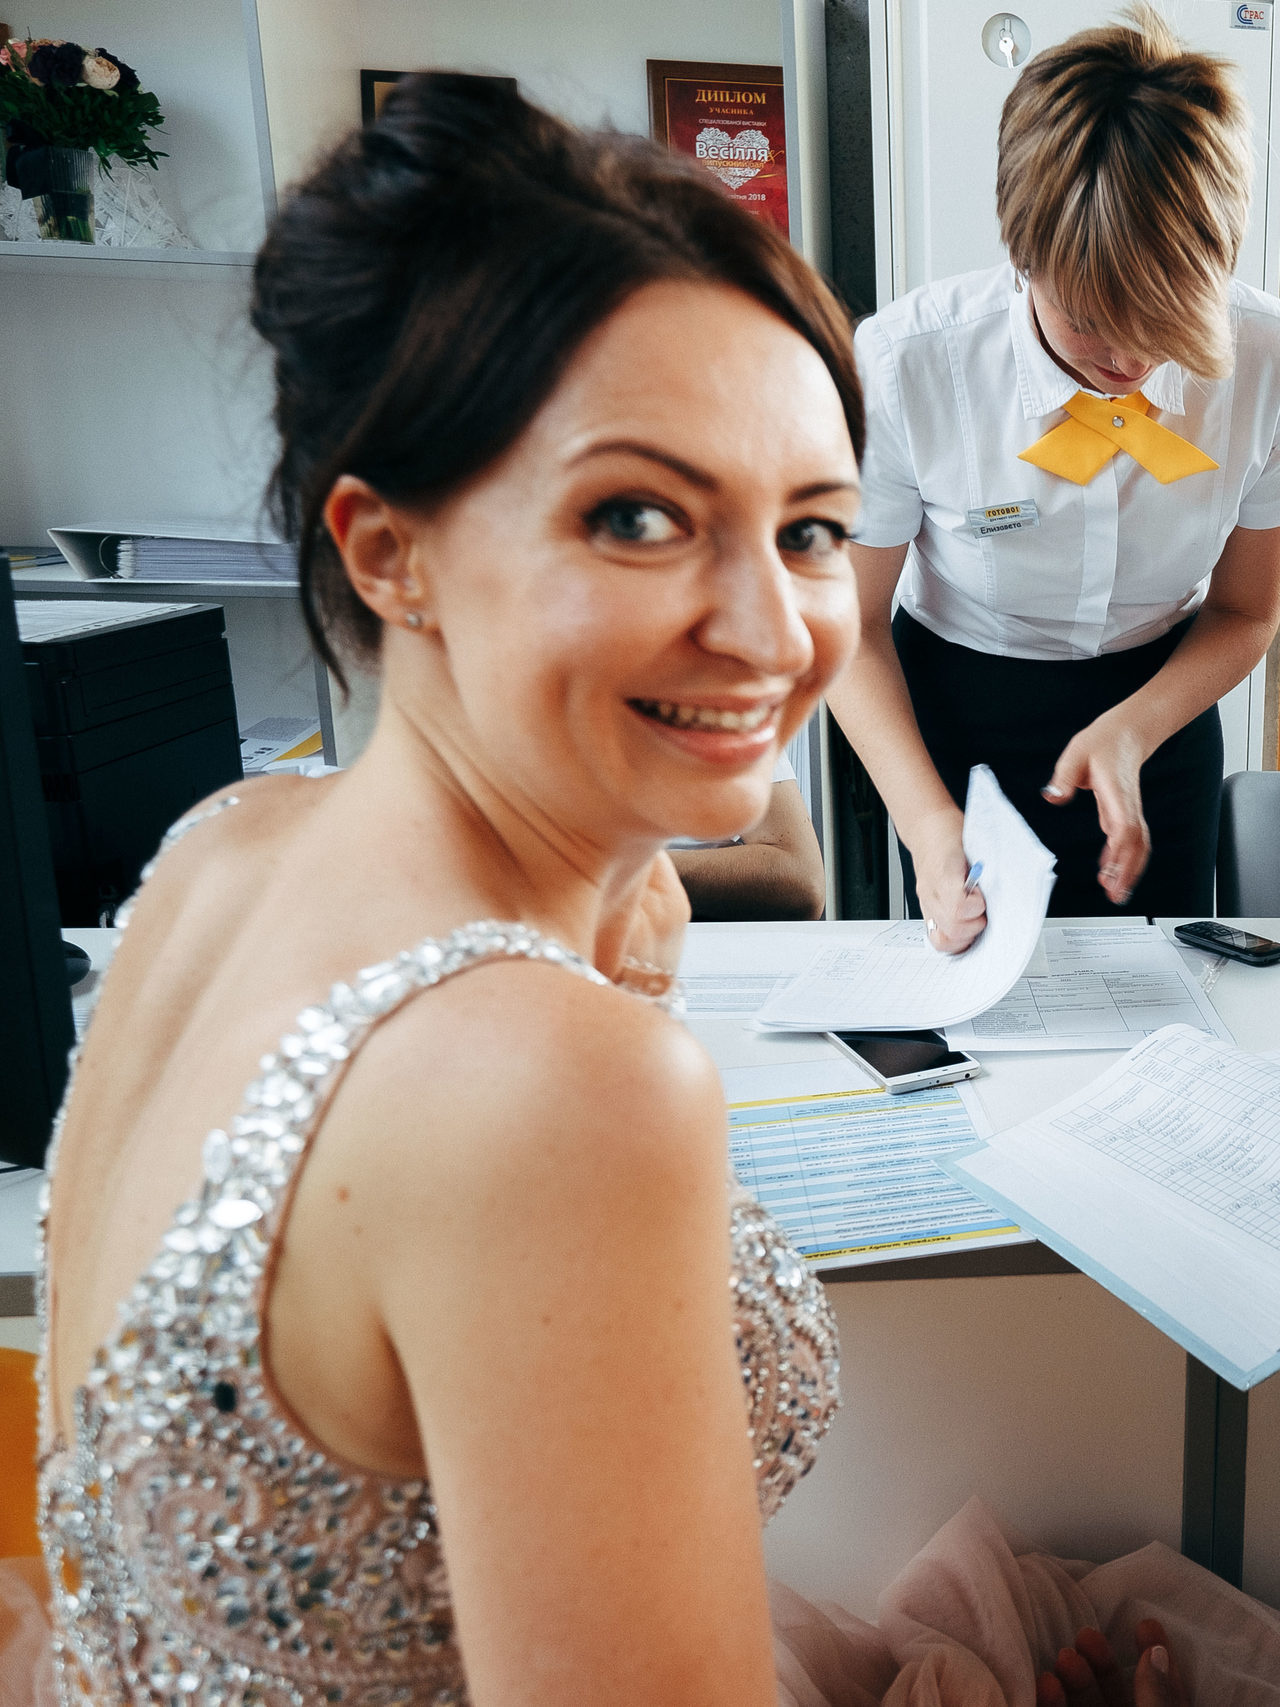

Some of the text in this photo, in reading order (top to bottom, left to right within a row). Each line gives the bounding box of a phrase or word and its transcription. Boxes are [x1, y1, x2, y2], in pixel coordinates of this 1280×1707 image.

[695, 89, 767, 104] ДИПЛОМ
[708, 106, 754, 115] УЧАСНИКА
[695, 141, 768, 162] Весілля
[747, 193, 766, 201] 2018
[987, 506, 1019, 517] ГОТОВО!
